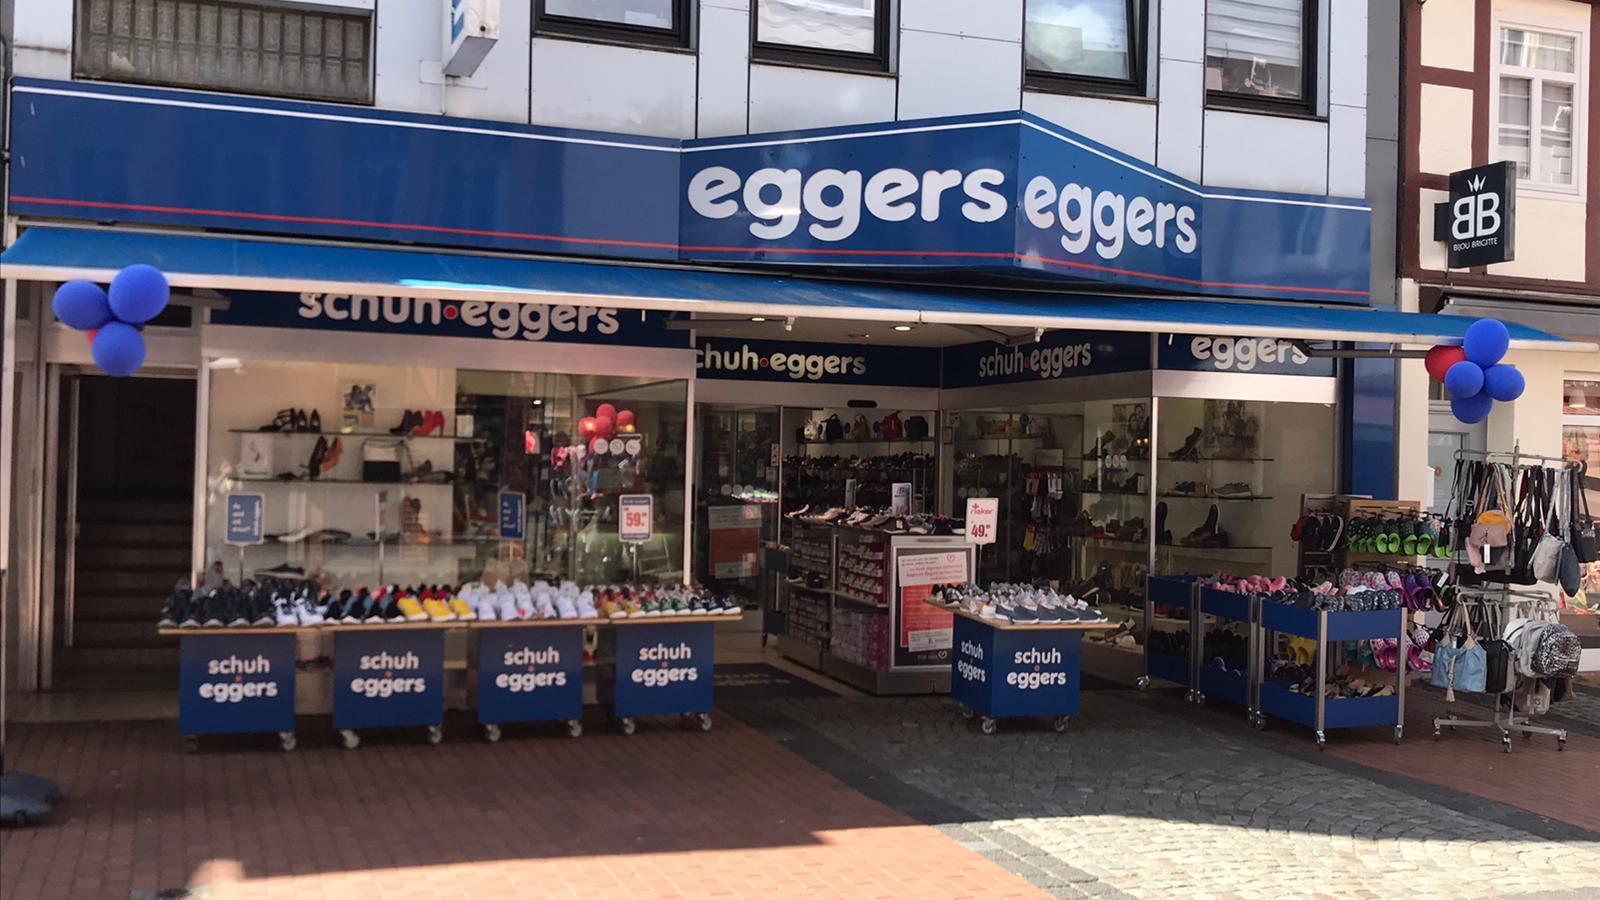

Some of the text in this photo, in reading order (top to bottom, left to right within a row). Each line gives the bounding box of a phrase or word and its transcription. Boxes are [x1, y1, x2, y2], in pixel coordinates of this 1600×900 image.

[688, 166, 1007, 241] eggers
[1024, 176, 1197, 259] eggers
[1453, 237, 1498, 252] BIJOU BRIGITTE
[460, 300, 619, 341] eggers
[979, 343, 1092, 378] schuh eggers
[1190, 336, 1309, 371] eggers
[770, 352, 866, 380] eggers
[360, 651, 419, 669] schuh
[504, 646, 560, 665] schuh
[639, 643, 692, 661] schuh
[961, 640, 984, 660] schuh
[1014, 648, 1061, 664] schuh
[208, 654, 270, 674] schuh
[957, 660, 986, 682] eggers
[351, 677, 426, 697] eggers
[495, 671, 567, 692] eggers
[631, 667, 698, 687] eggers
[1006, 671, 1066, 689] eggers
[199, 681, 278, 702] eggers
